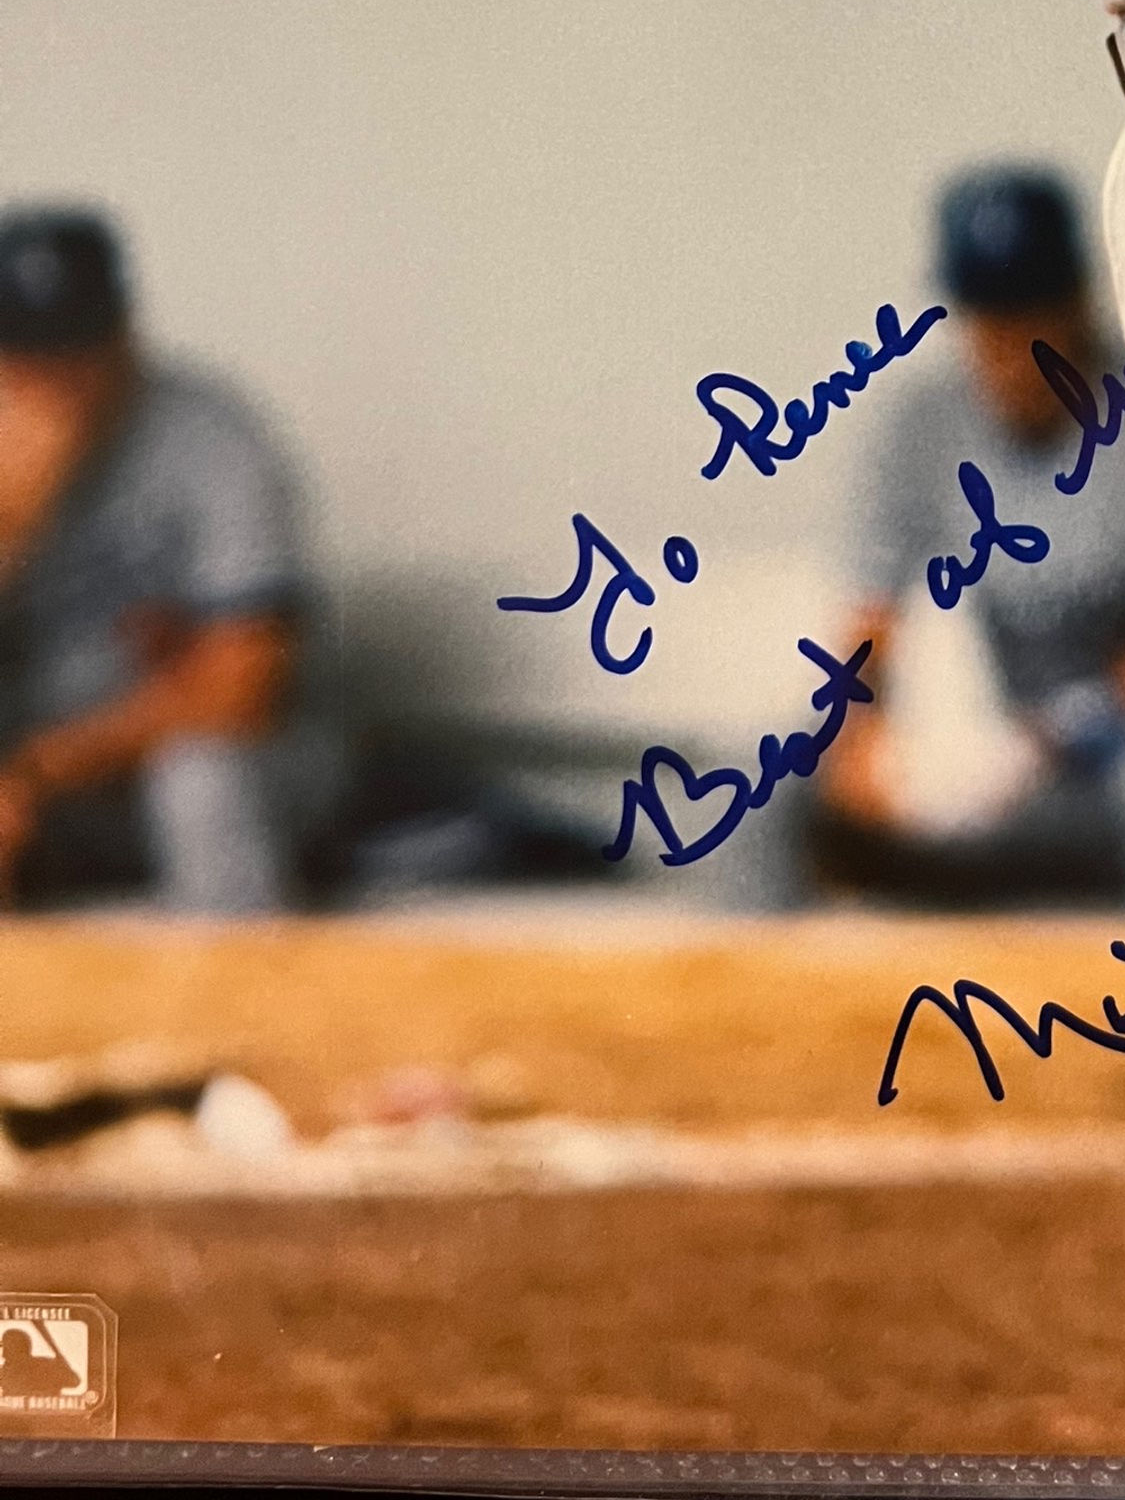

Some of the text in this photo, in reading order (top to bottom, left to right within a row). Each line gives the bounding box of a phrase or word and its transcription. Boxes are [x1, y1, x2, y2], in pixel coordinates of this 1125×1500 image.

[496, 512, 700, 676] To
[602, 637, 875, 867] Best
[926, 461, 1052, 611] of
